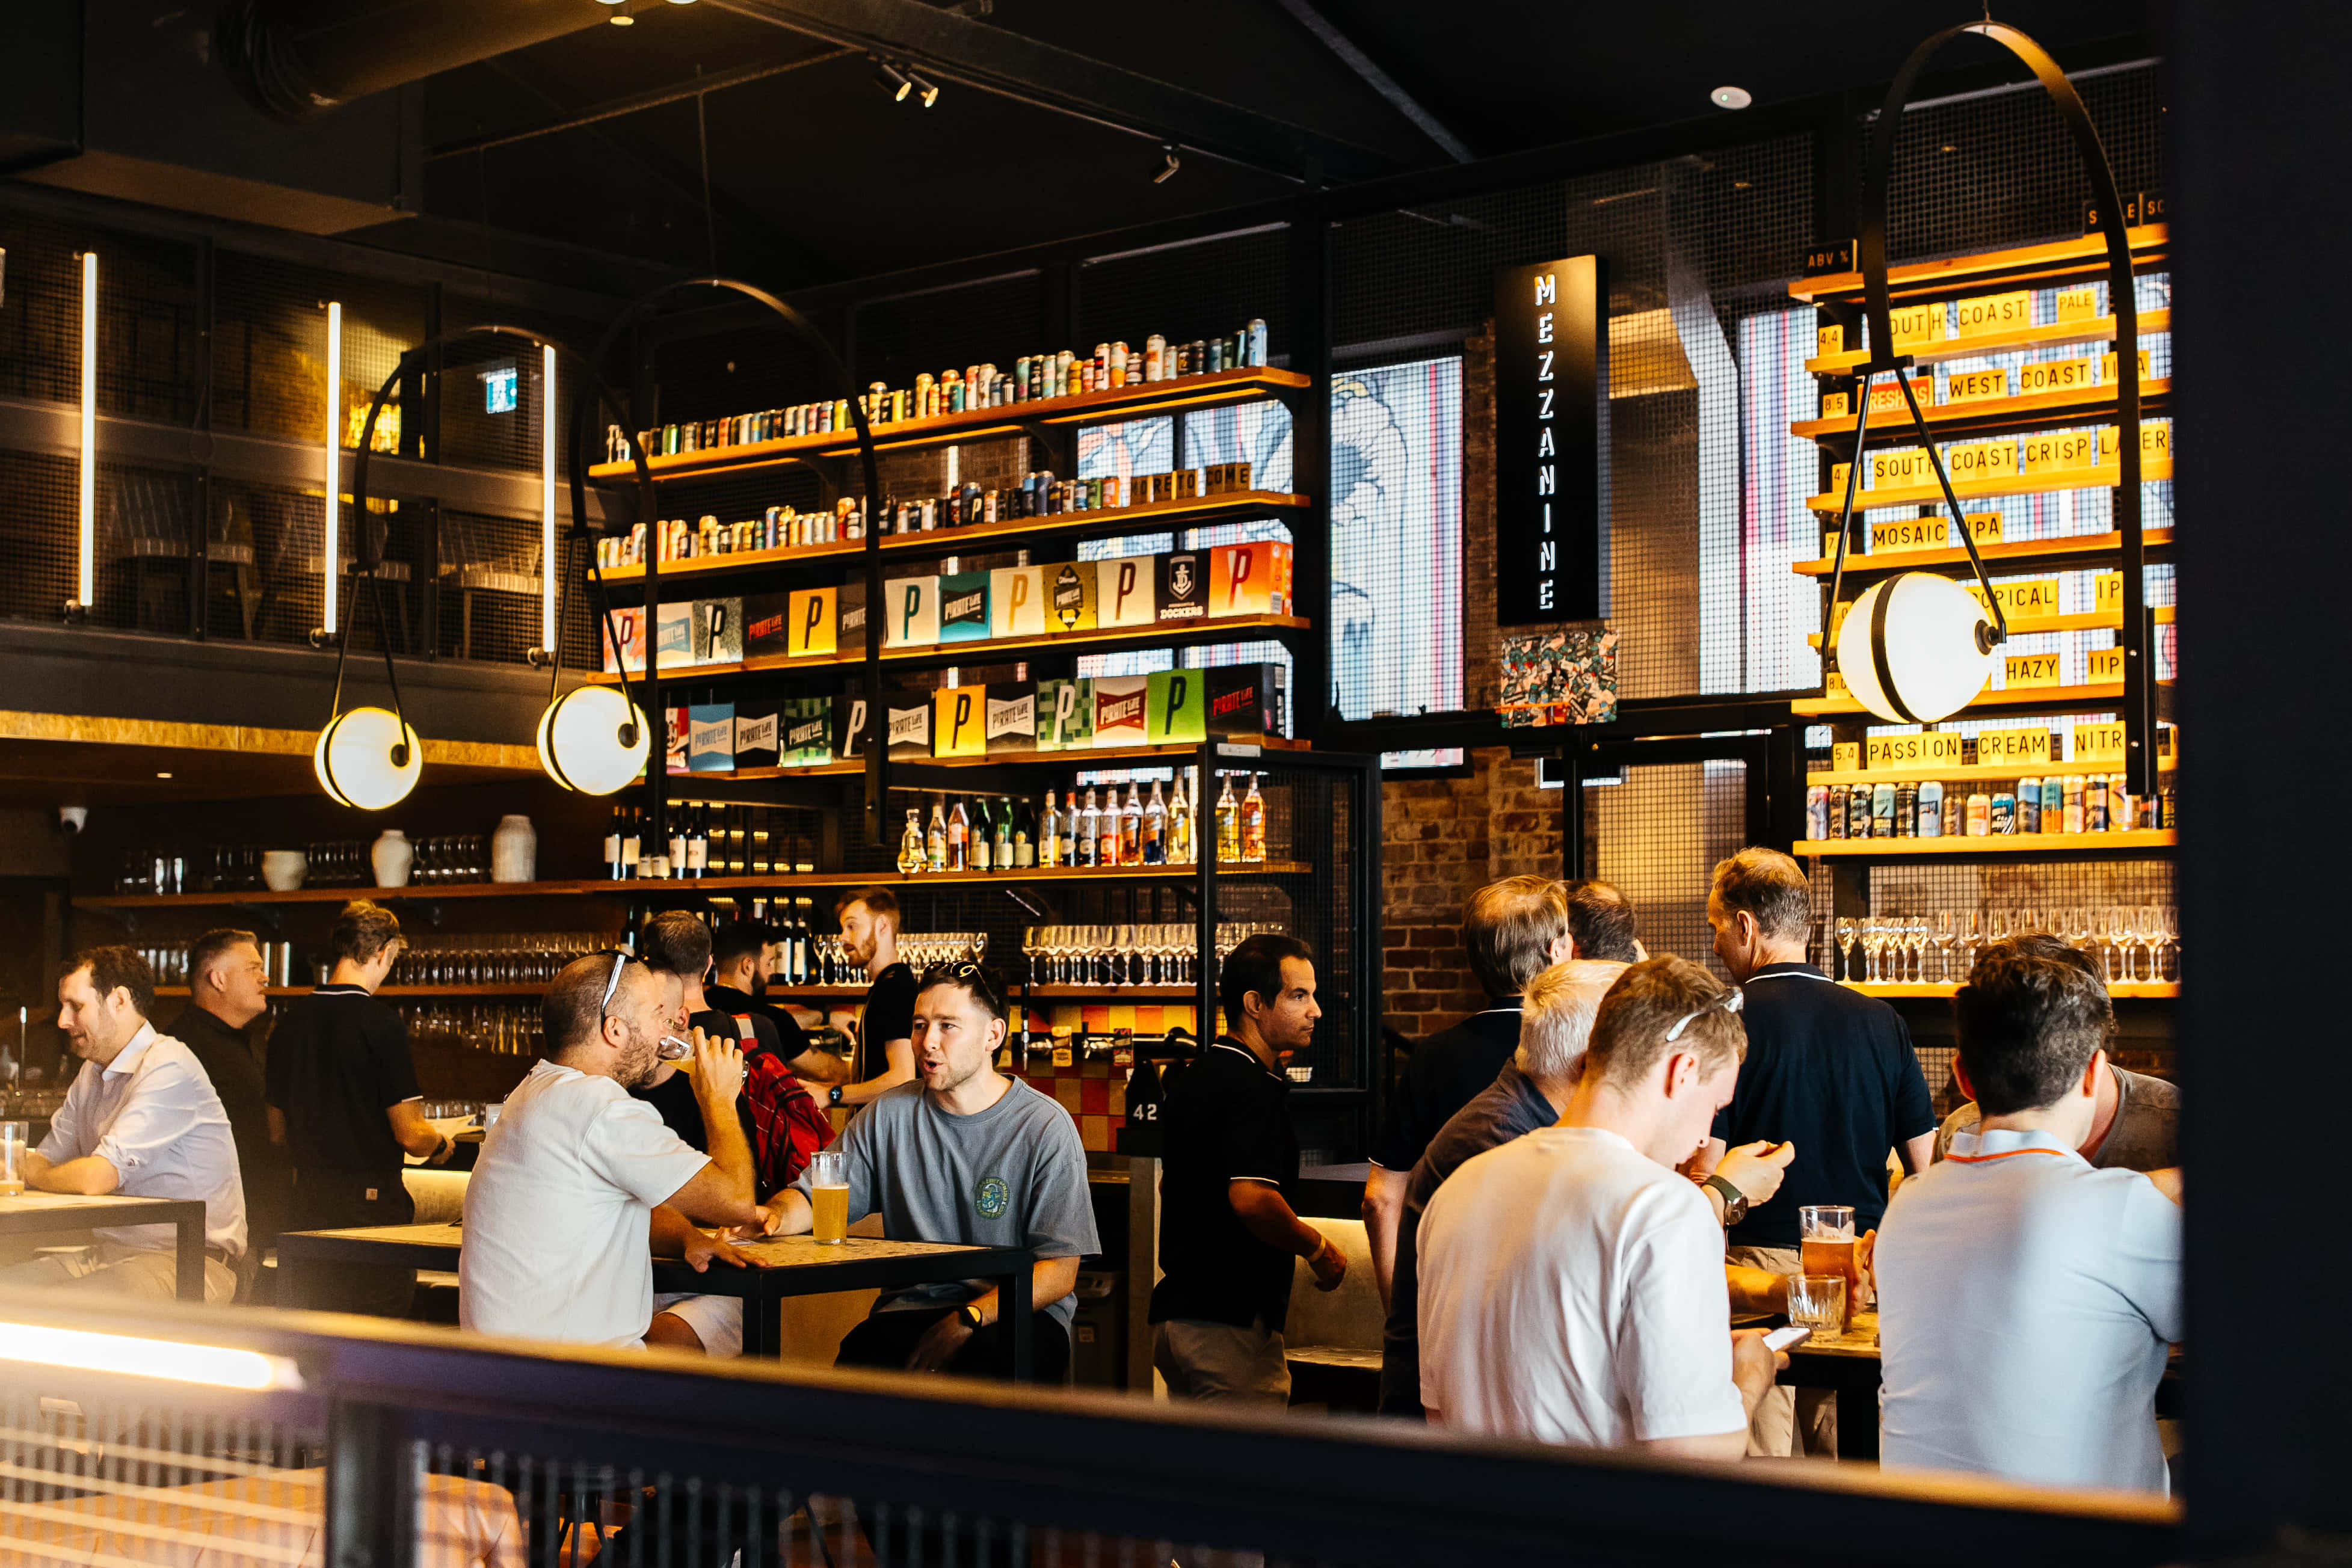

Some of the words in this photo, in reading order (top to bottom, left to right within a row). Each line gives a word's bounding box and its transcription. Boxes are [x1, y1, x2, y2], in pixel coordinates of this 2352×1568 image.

[1808, 252, 1833, 269] ABV
[1839, 250, 1849, 263] %
[1891, 312, 1942, 336] OUTH
[1959, 299, 2025, 325] COAST
[2059, 292, 2092, 309] PALE
[1820, 330, 1838, 345] 4.4
[1949, 374, 2003, 397] WEST
[2021, 364, 2087, 389] COAST
[2104, 357, 2146, 379] IIA
[1868, 389, 1905, 411] RESH
[1535, 274, 1556, 610] MEZZANINE
[1952, 447, 2013, 471] COAST
[2027, 438, 2087, 463] CRISP
[2101, 430, 2166, 455] LER
[1131, 475, 1172, 495] MORE
[1177, 474, 1195, 490] TO
[1207, 467, 1249, 486] COME
[1873, 524, 1945, 547] MOSAIC
[1967, 517, 2000, 538] IPA
[1115, 562, 1136, 621] P
[1228, 548, 1253, 608] P
[1972, 586, 2053, 609] OPICAL
[2099, 581, 2120, 598] IP
[804, 595, 823, 650] P
[904, 585, 921, 640] P
[1008, 574, 1029, 631] P
[1160, 605, 1204, 620] DOCKERS
[707, 604, 727, 659] P
[2006, 659, 2057, 680] HAZY
[2090, 657, 2119, 674] IIP
[952, 693, 971, 749] P
[993, 706, 1017, 729] PIRATE
[1053, 684, 1076, 744] P
[1165, 675, 1187, 735] P
[1213, 690, 1240, 716] PIRATE
[740, 724, 761, 746] PIRATE
[843, 699, 867, 757] P
[1870, 738, 1957, 761] PASSION
[1980, 735, 2045, 754] CREAM
[2075, 730, 2122, 751] NITR
[1133, 1103, 1157, 1121] 42
